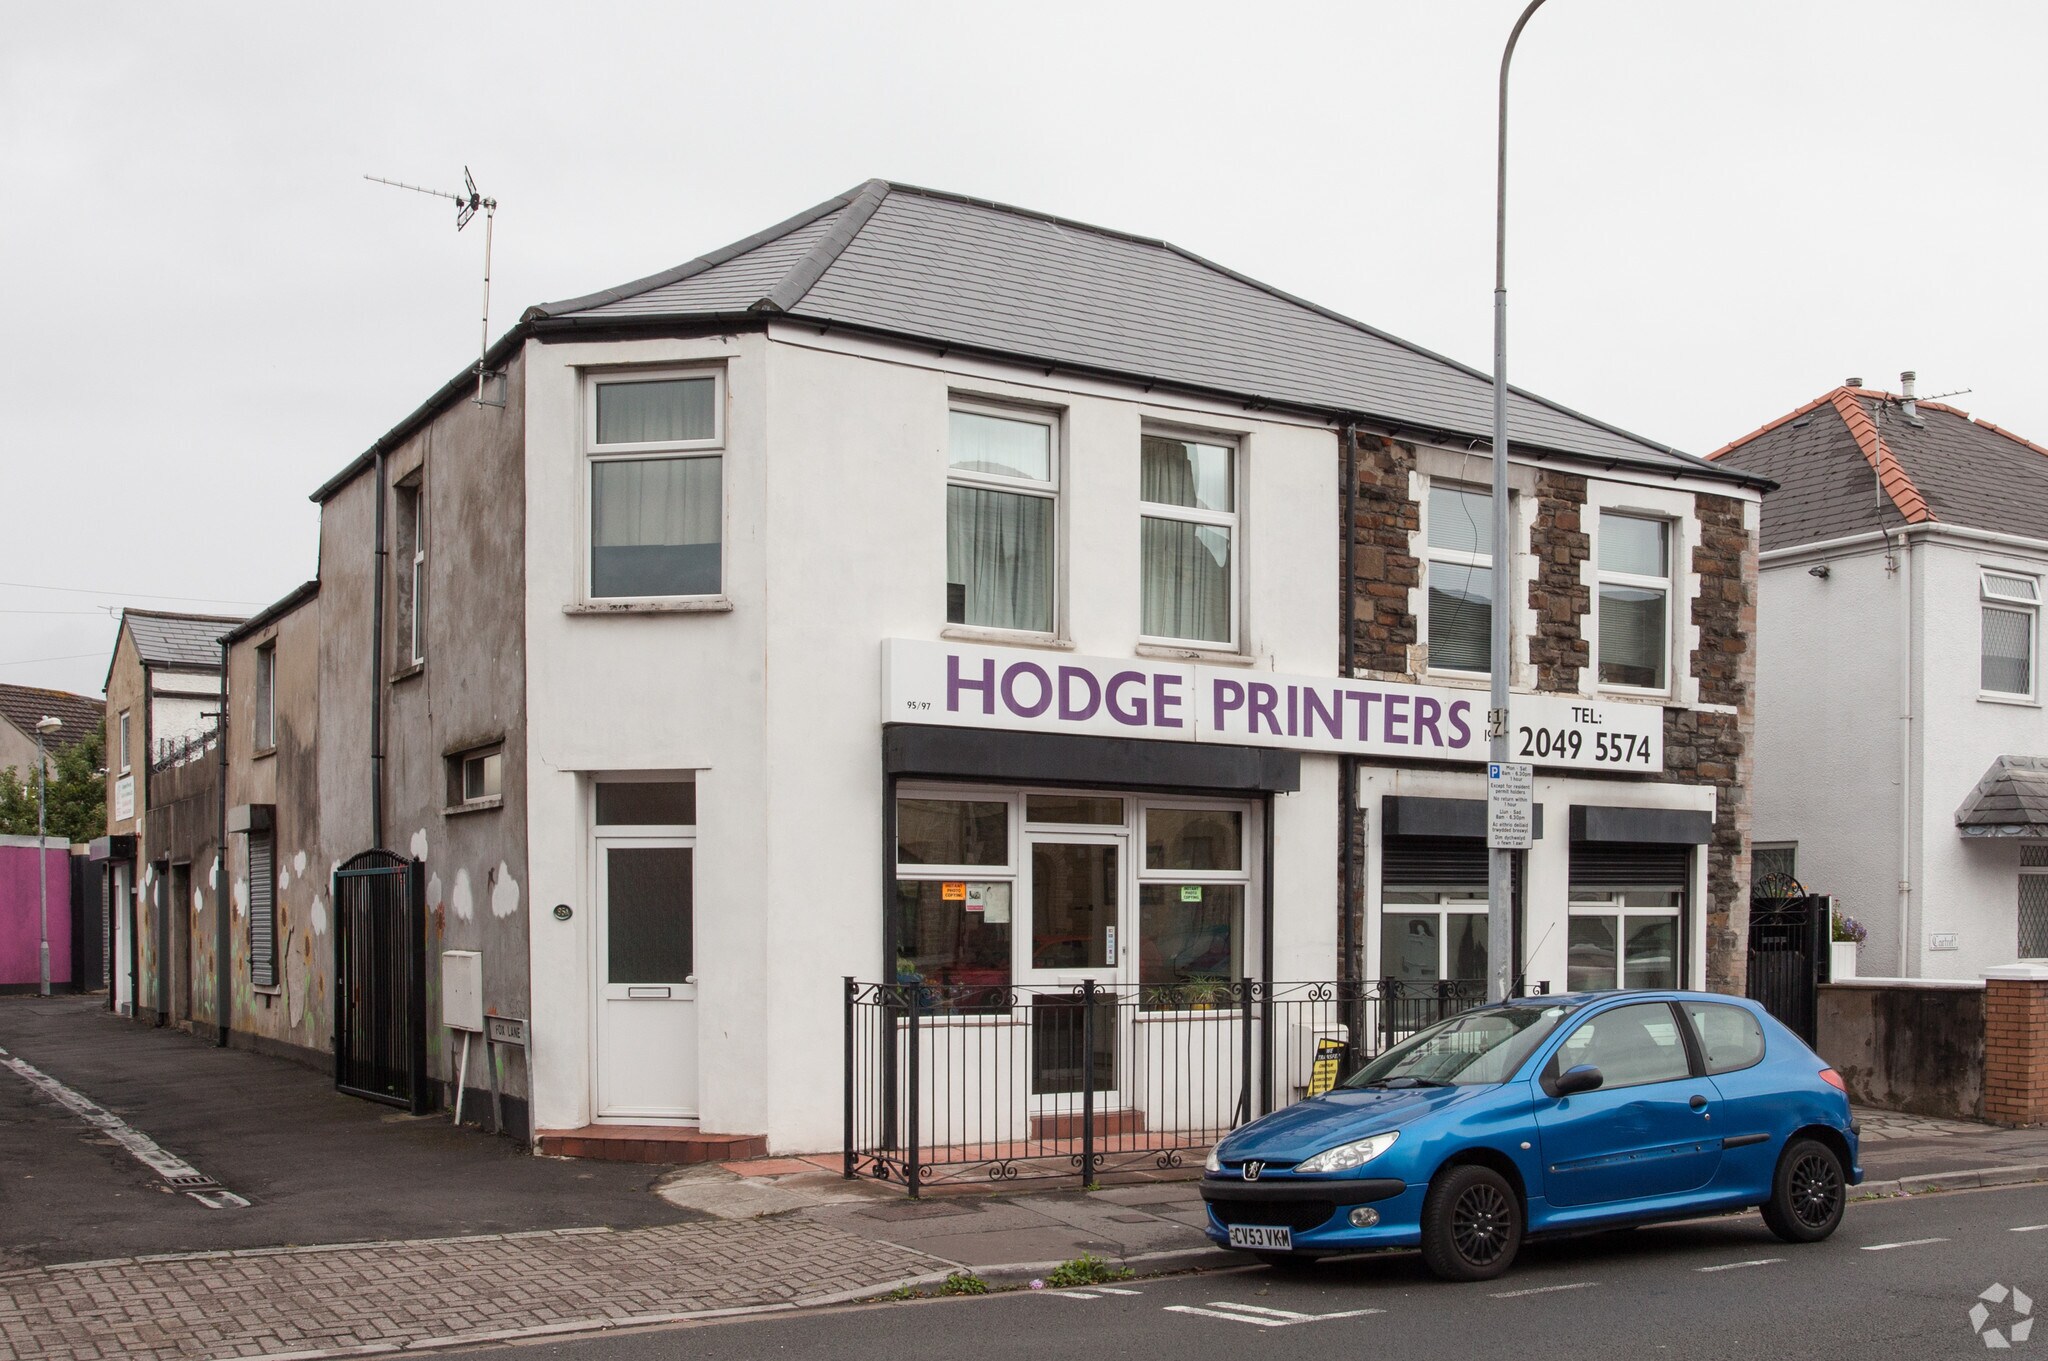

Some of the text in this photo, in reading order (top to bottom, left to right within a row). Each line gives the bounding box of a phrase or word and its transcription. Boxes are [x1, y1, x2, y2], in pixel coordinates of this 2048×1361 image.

[907, 700, 931, 711] 95/97
[946, 655, 1471, 749] HODGE PRINTERS
[1571, 707, 1602, 725] TEL:
[1519, 727, 1583, 759] 2049
[1595, 732, 1651, 764] 5574
[1492, 767, 1498, 777] P
[495, 1024, 520, 1038] FOX LANE
[1235, 1228, 1290, 1247] CV53 VKM
